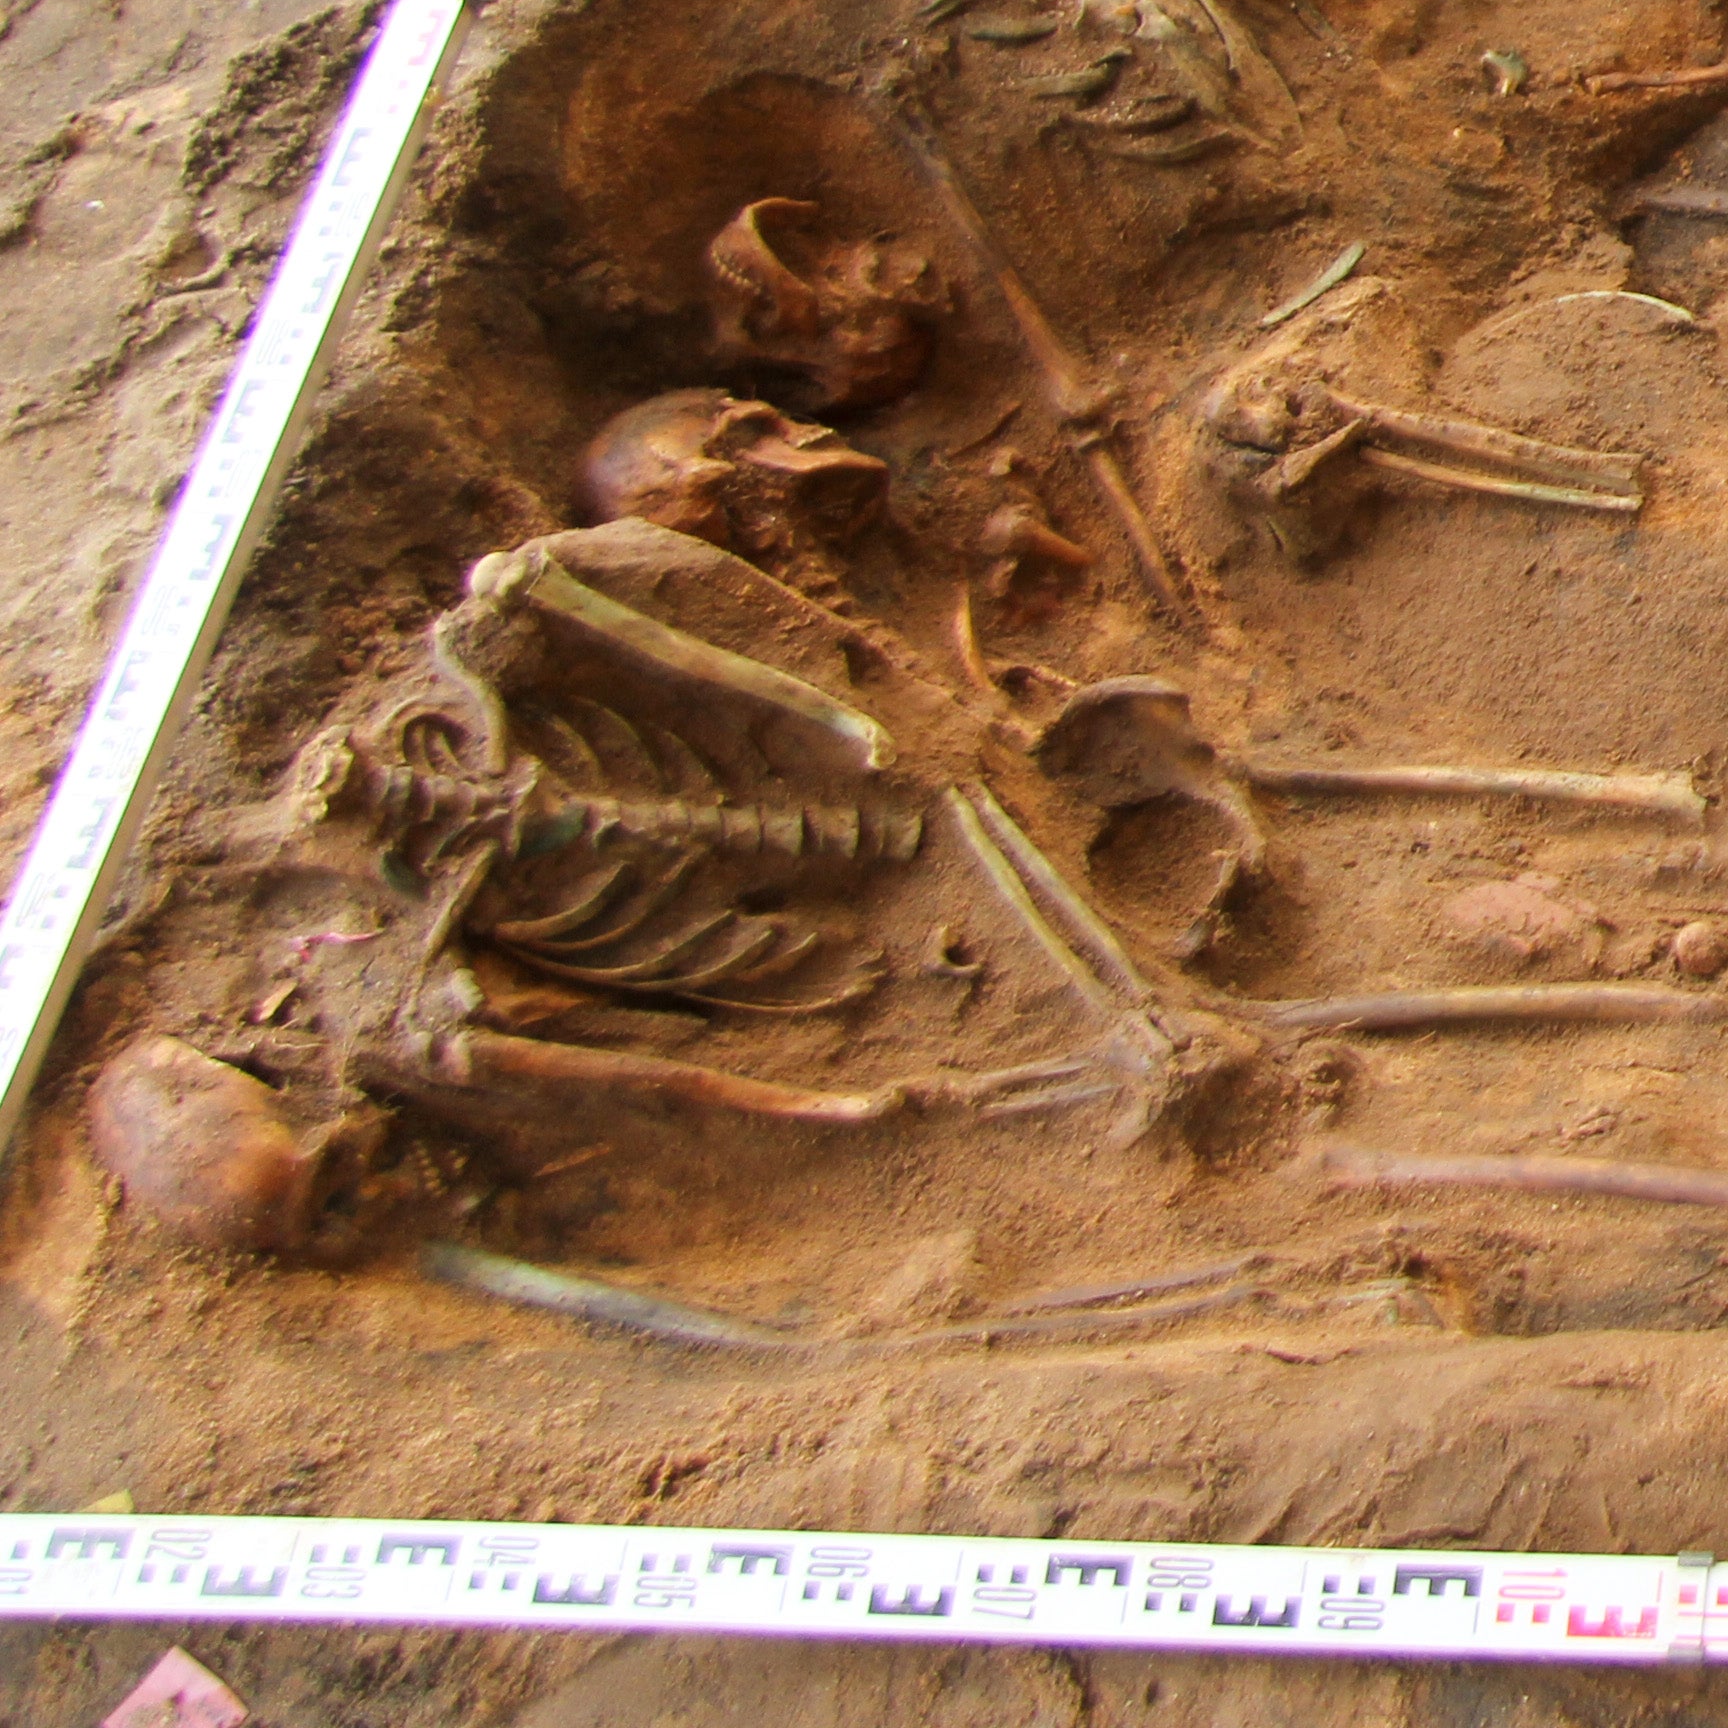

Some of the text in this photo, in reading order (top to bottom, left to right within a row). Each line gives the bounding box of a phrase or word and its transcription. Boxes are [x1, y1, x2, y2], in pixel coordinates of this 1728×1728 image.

[147, 1527, 213, 1561] 02
[478, 1535, 542, 1568] 04
[805, 1545, 874, 1580] 06
[1147, 1555, 1215, 1593] 08
[300, 1566, 366, 1599] 03
[632, 1575, 698, 1610] 05
[1497, 1567, 1568, 1603] 10
[972, 1587, 1040, 1622] 07
[1318, 1593, 1386, 1633] 09
